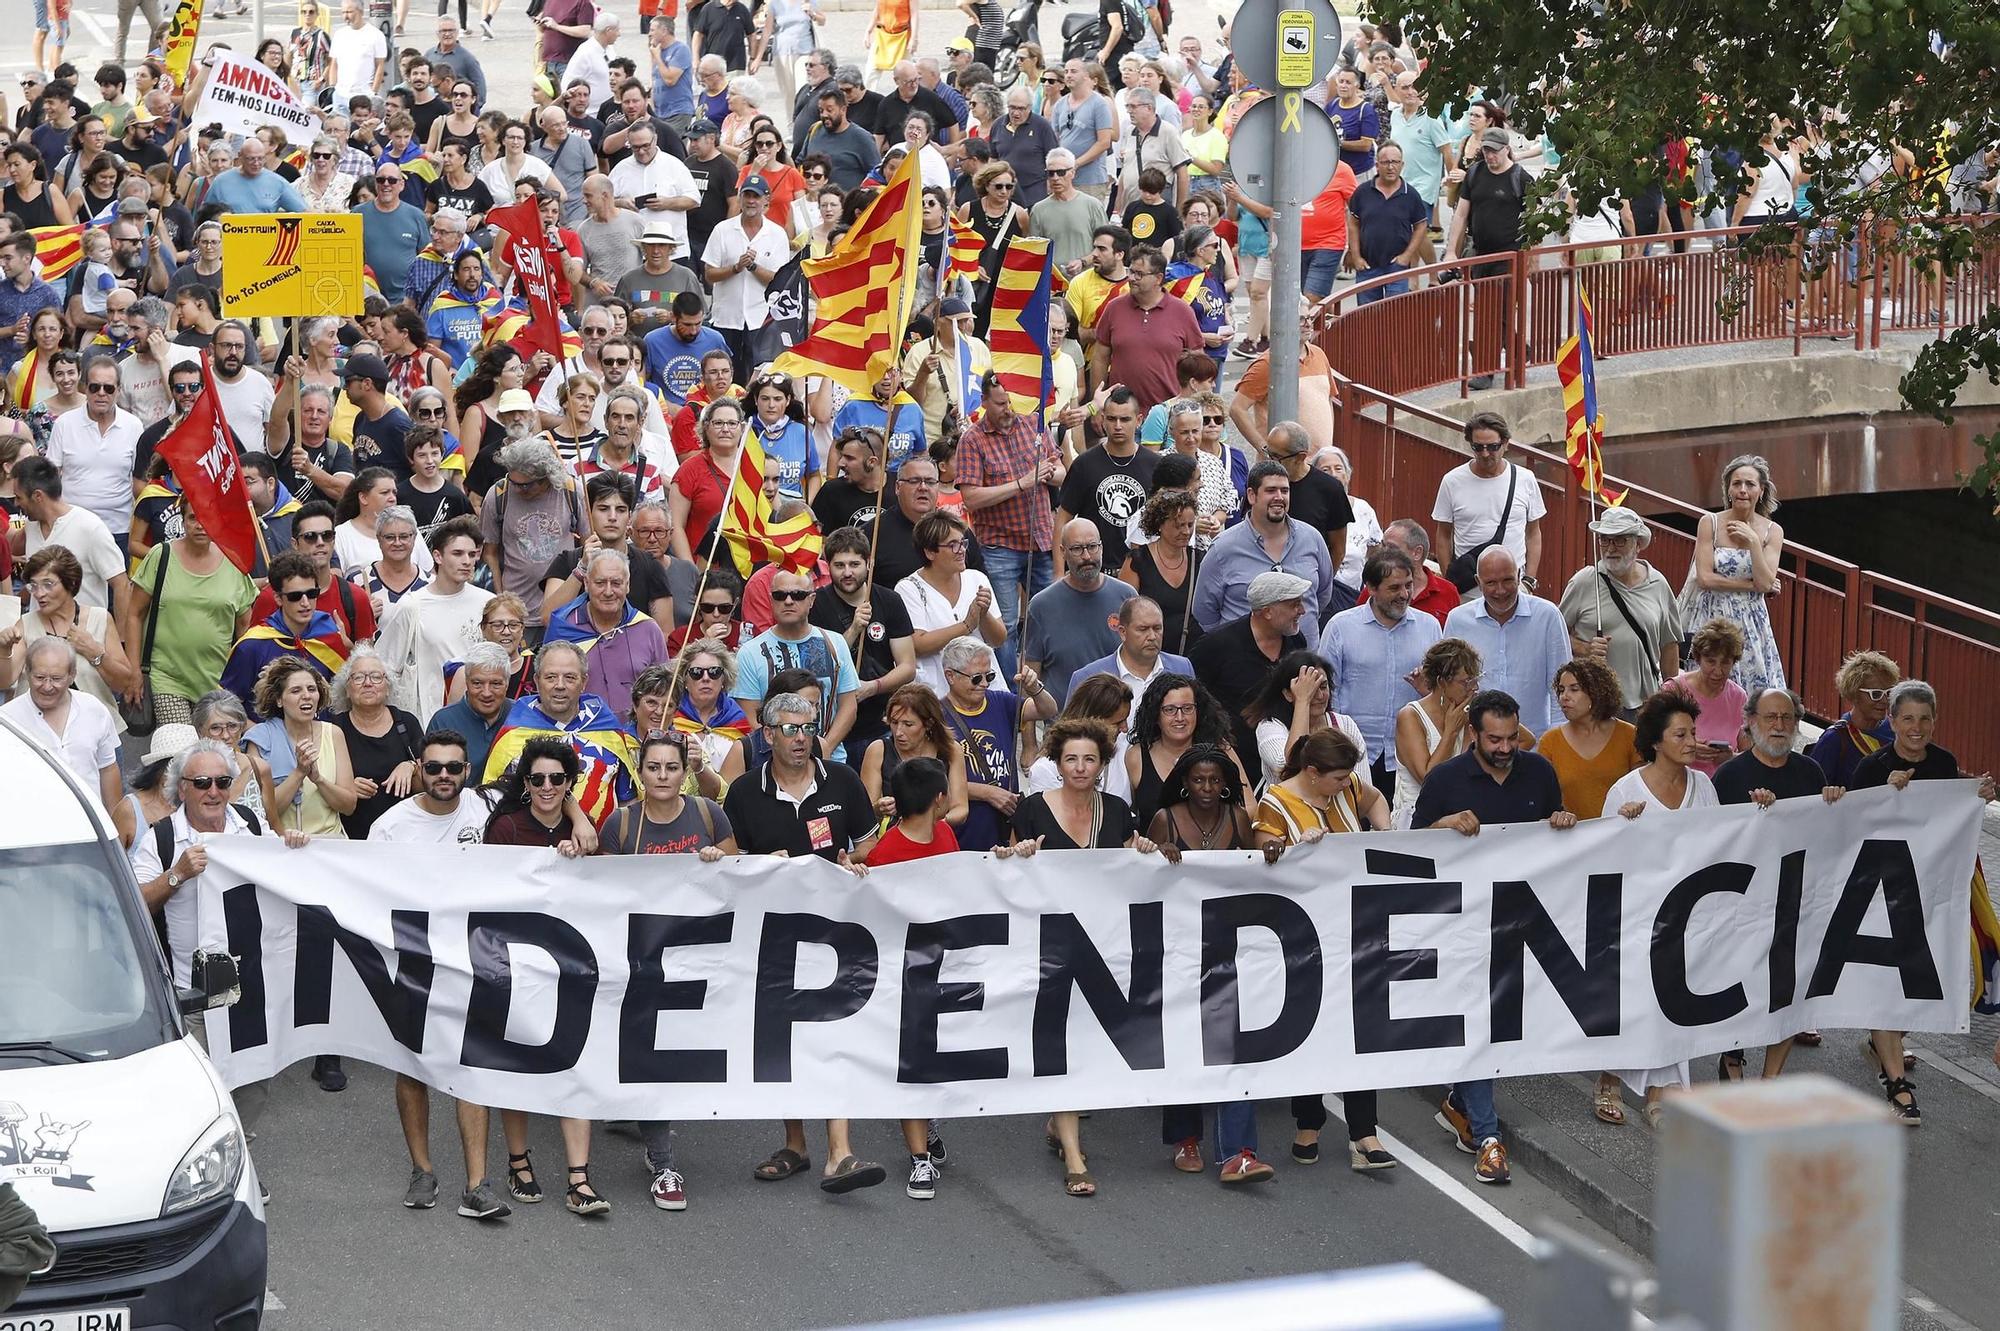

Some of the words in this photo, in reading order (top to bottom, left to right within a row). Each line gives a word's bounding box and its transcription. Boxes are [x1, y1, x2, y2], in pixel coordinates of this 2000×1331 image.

[211, 87, 263, 112] FEM-NOS
[264, 102, 311, 127] LLIURES
[438, 196, 475, 210] STAY
[448, 324, 482, 333] CONSTR
[672, 370, 697, 380] VANS
[779, 461, 801, 469] RUIR
[1106, 484, 1136, 500] SHARP
[222, 839, 1944, 1085] INDEPENDÈNCIA
[34, 1166, 57, 1175] Roll
